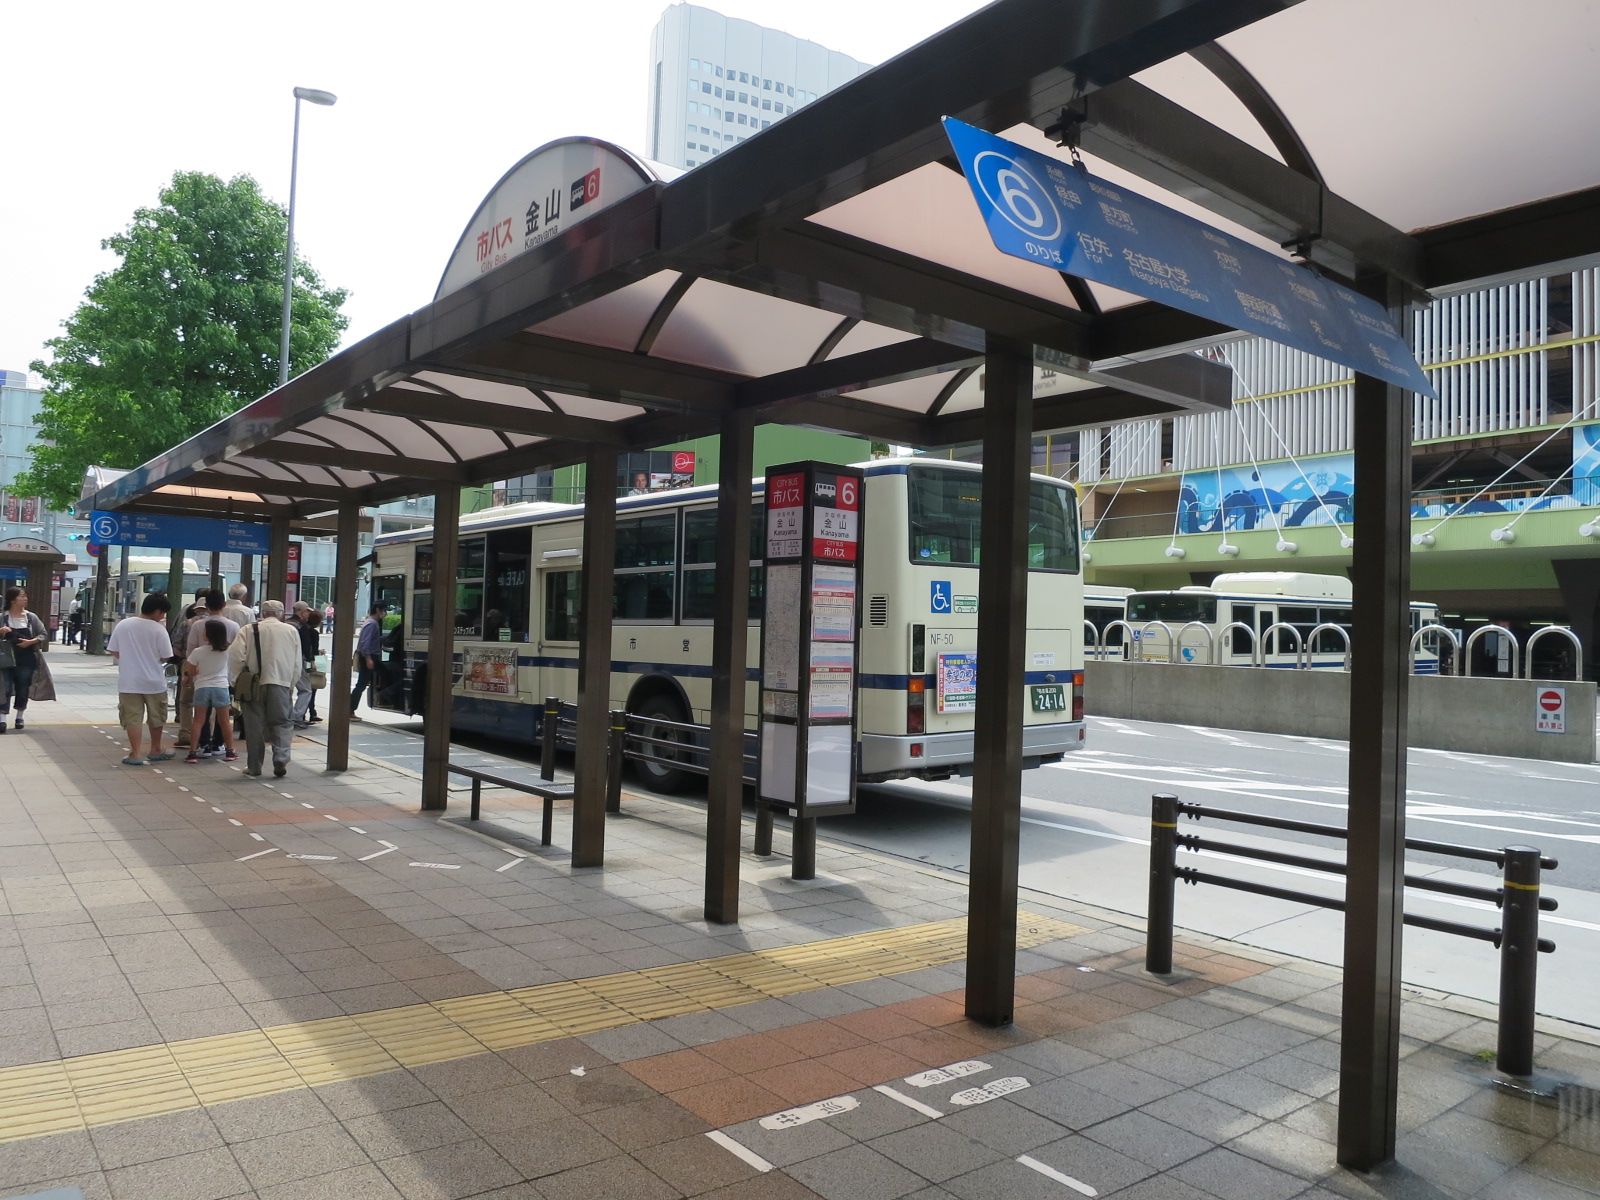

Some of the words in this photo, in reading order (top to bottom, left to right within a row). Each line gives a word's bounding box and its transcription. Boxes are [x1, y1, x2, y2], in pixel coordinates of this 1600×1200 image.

[586, 174, 596, 198] 6
[997, 168, 1044, 228] 6
[525, 188, 561, 237] 金山
[477, 216, 513, 263] 市バス
[524, 224, 559, 250] Kanayama
[1076, 231, 1113, 259] 行先
[480, 257, 494, 273] City
[494, 251, 508, 267] Bus
[1025, 241, 1064, 264] のりば
[1084, 247, 1104, 265] For
[1123, 247, 1191, 283] 名古屋大学
[1130, 265, 1171, 290] Nagoya
[773, 488, 800, 505] 市バス
[842, 482, 855, 505] 6
[100, 520, 112, 536] 5
[773, 529, 798, 537] Kanayama
[776, 517, 796, 529] 金山
[820, 529, 850, 539] Kanayama
[824, 518, 847, 530] 金山
[288, 546, 299, 559] 5
[824, 547, 845, 557] 市バス
[930, 633, 954, 645] NF-50
